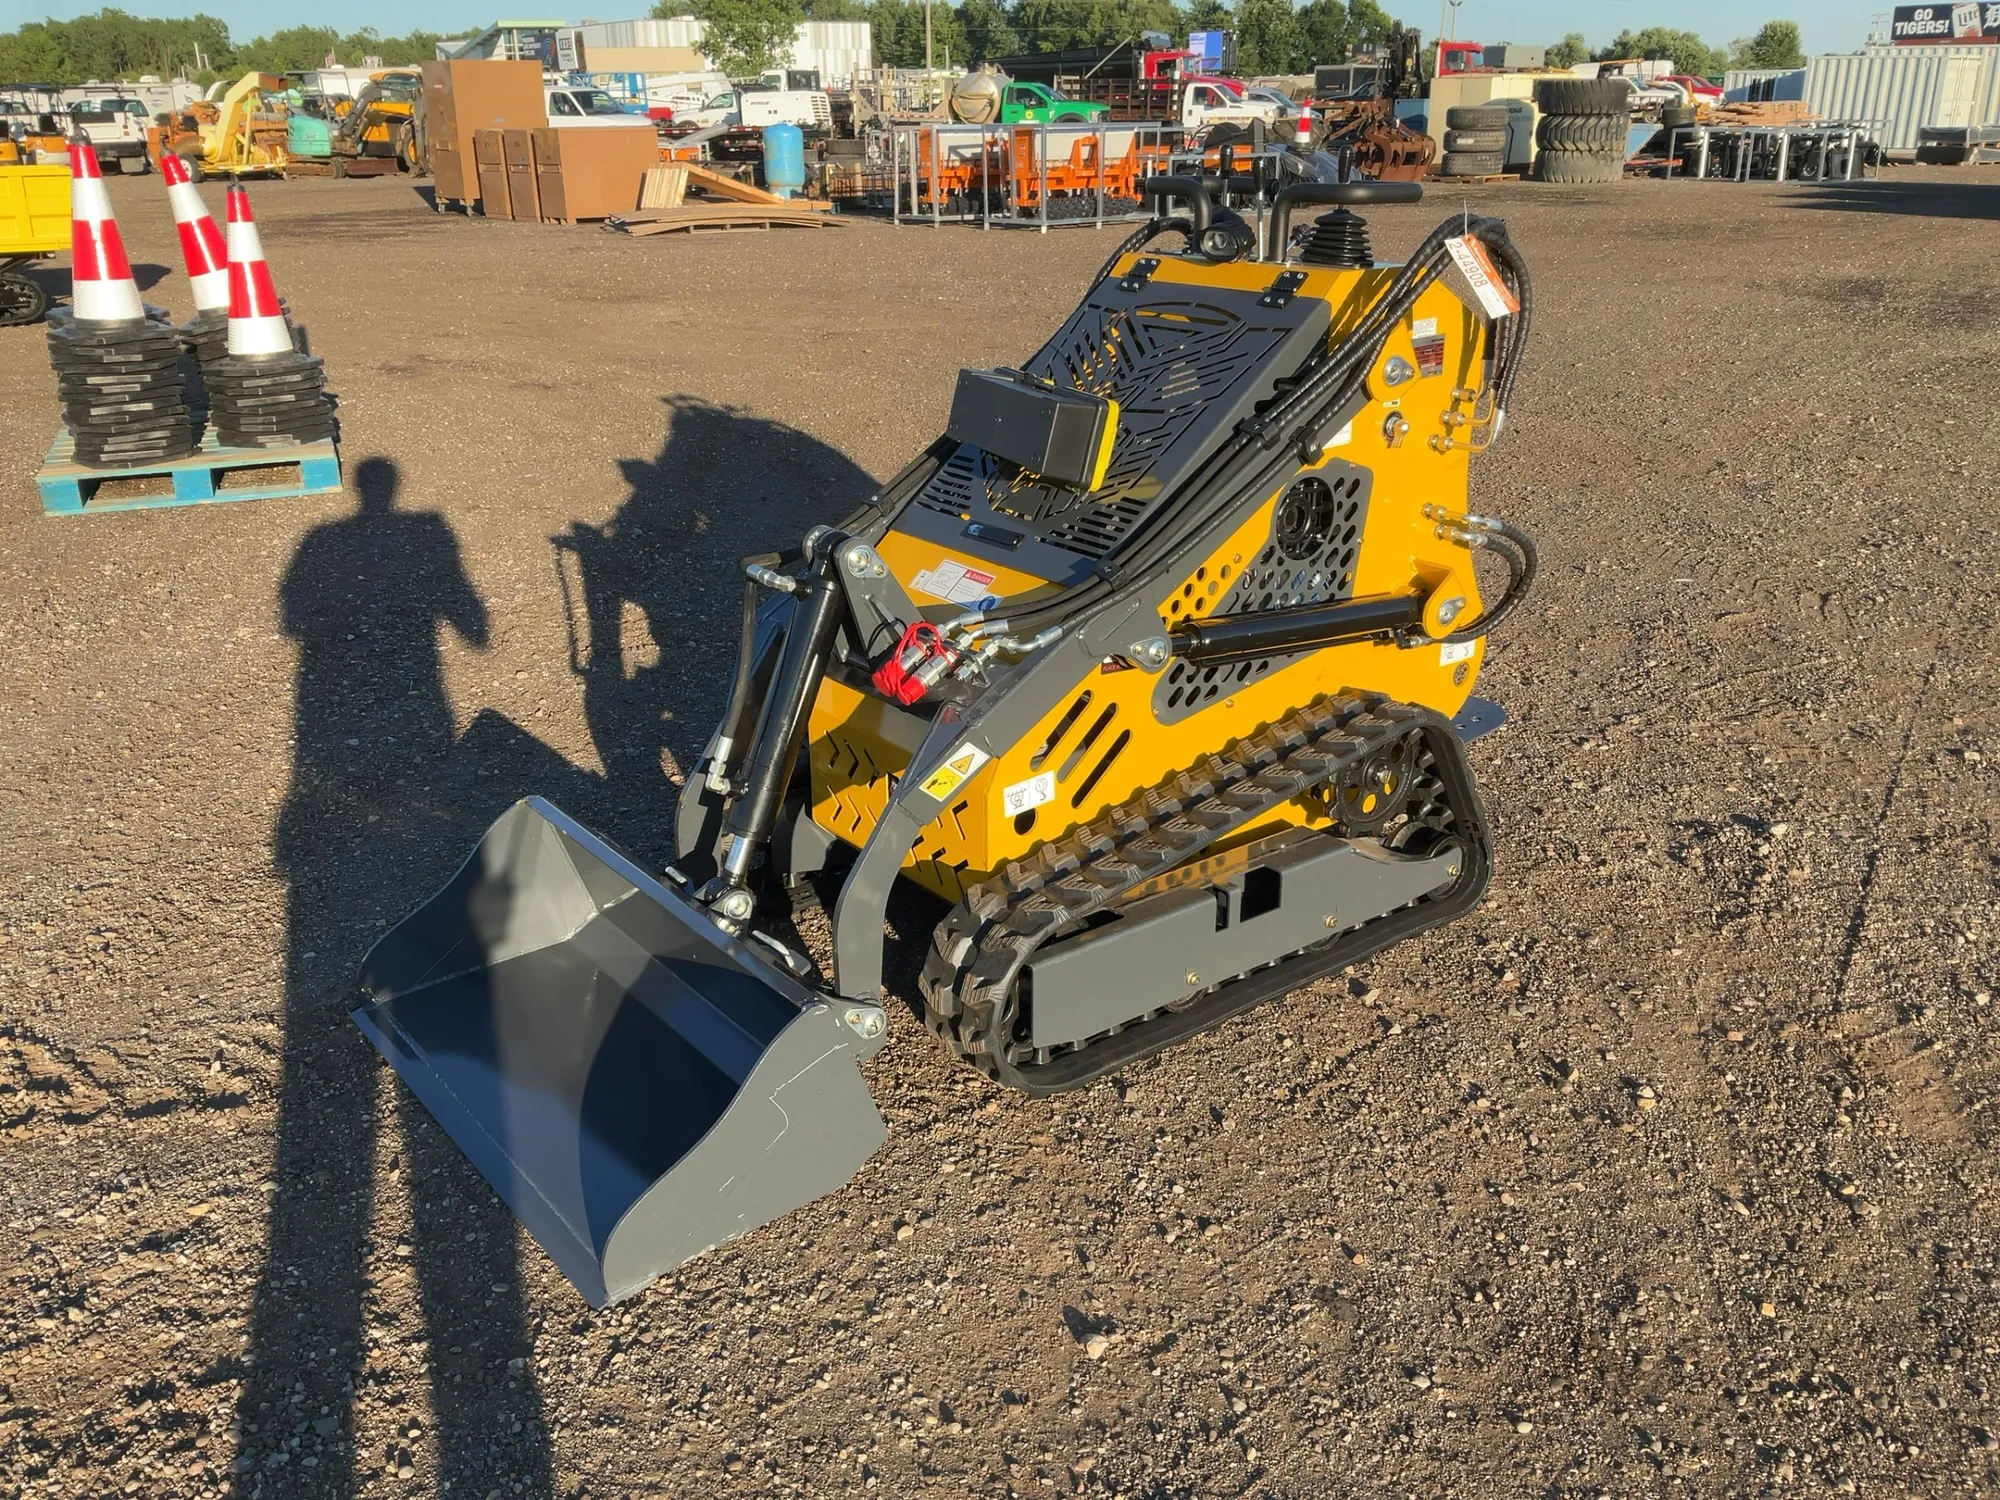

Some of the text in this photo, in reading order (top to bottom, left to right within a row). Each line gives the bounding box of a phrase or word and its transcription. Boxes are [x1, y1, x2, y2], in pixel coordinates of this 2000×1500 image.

[1914, 8, 1933, 21] GO
[1958, 9, 1978, 27] Lite
[1895, 19, 1950, 35] TIGERS!
[1449, 241, 1488, 288] 2-44908
